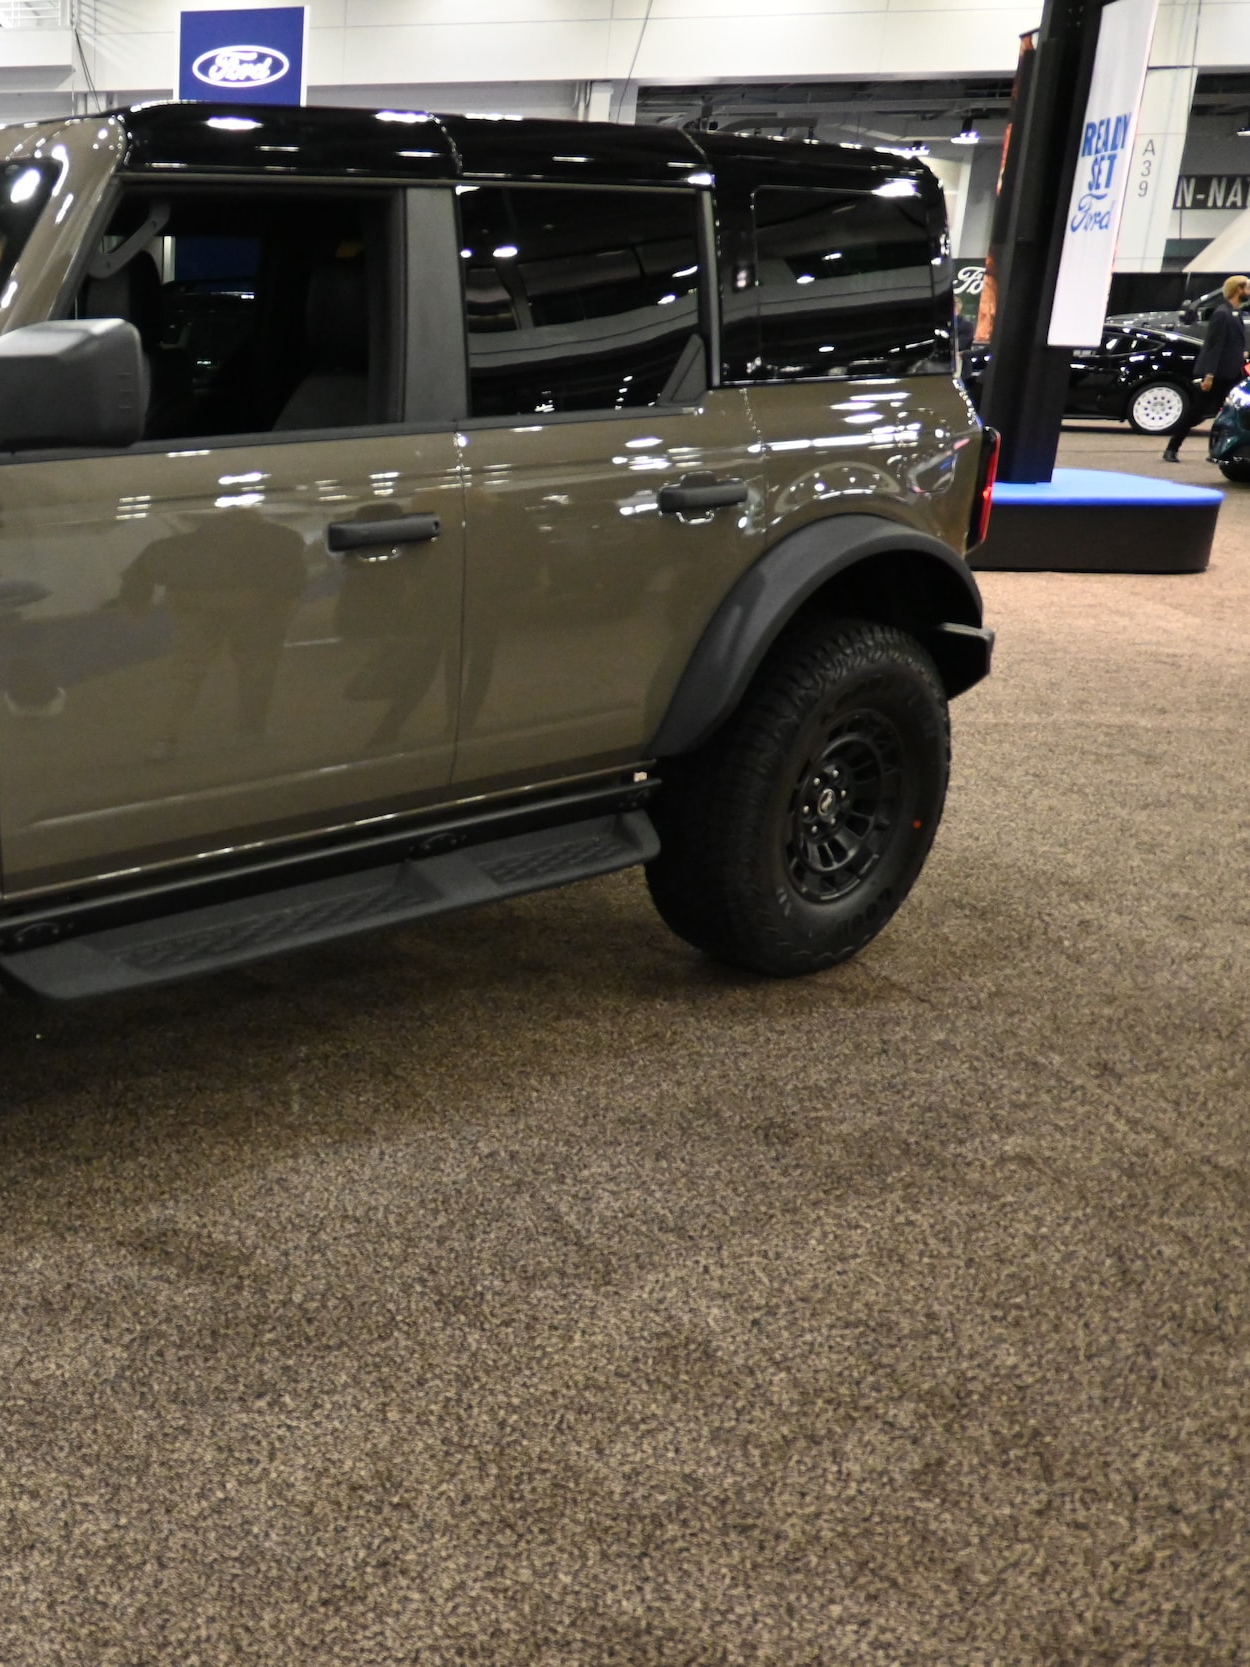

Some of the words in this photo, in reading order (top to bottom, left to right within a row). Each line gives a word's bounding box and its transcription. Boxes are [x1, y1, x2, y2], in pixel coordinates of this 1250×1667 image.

[208, 51, 273, 80] Ford
[1081, 112, 1132, 157] READY
[1088, 153, 1118, 191] SET
[1070, 193, 1117, 232] Ford
